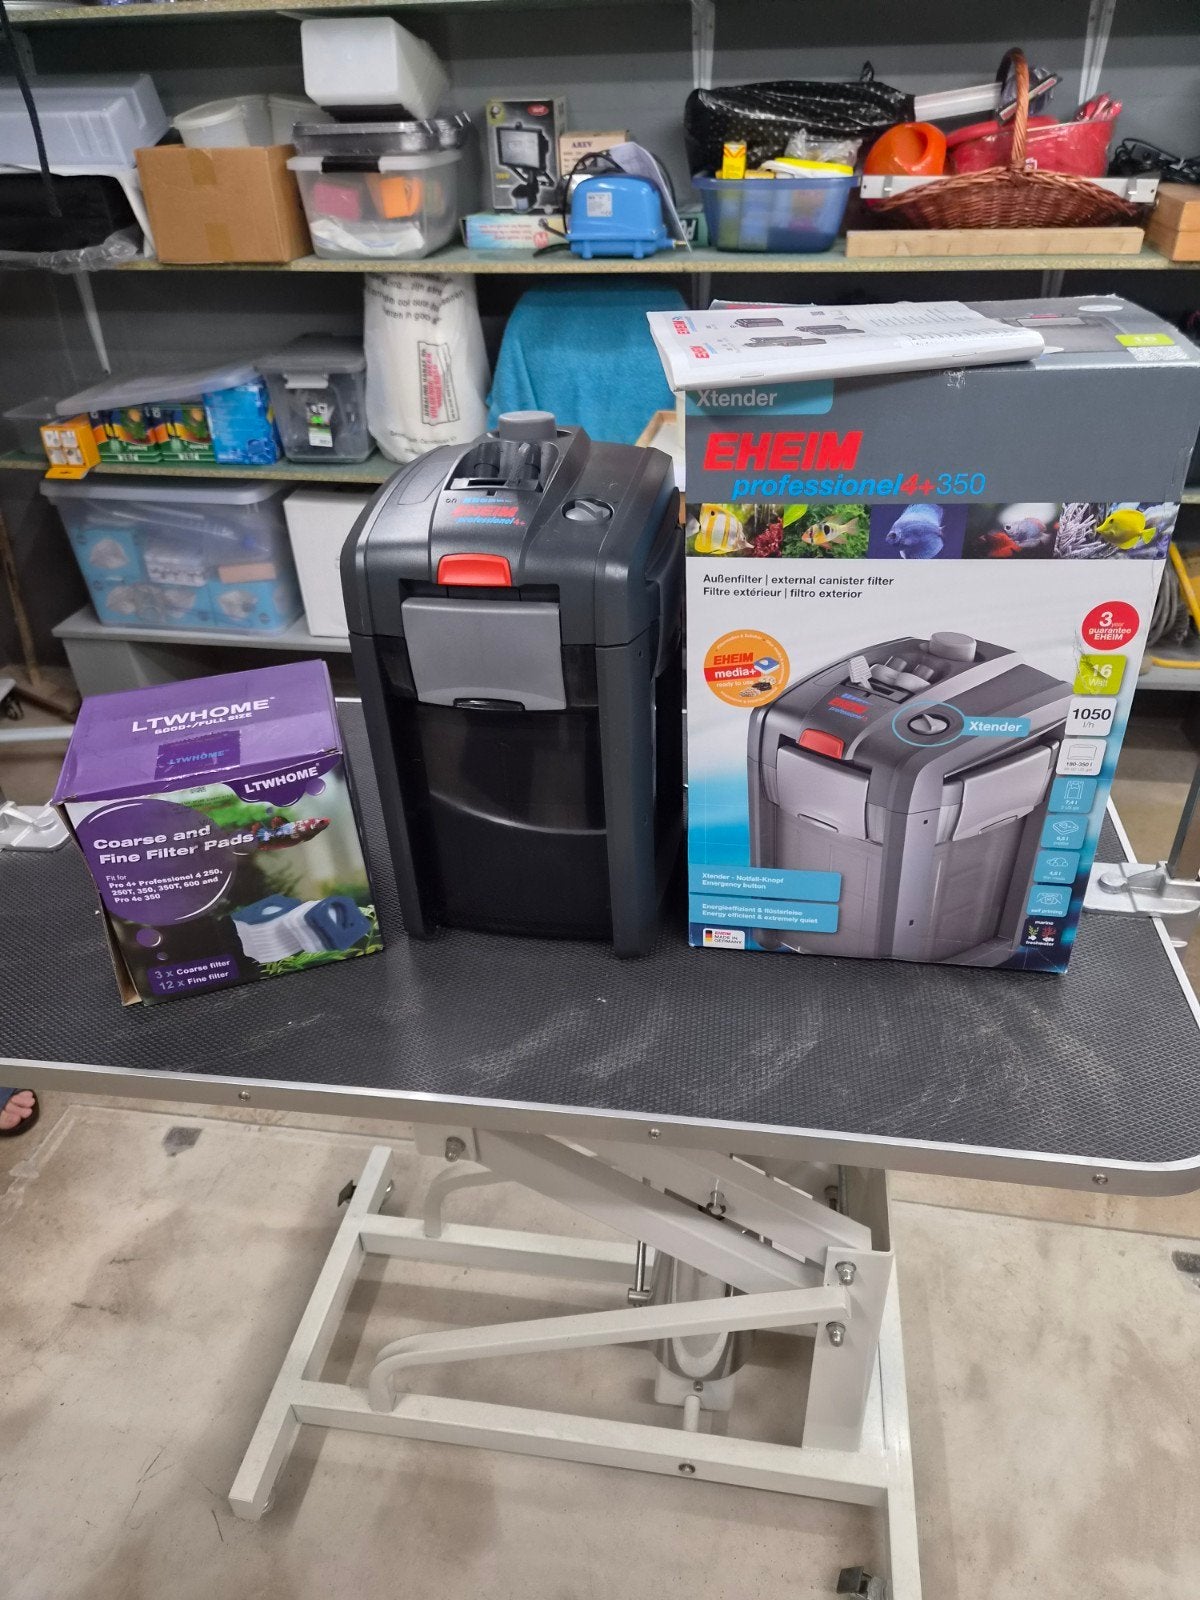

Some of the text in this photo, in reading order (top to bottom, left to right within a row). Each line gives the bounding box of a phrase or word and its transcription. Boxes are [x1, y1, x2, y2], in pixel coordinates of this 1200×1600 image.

[696, 389, 777, 407] Xtender
[703, 430, 864, 471] EHEIM
[703, 574, 763, 584] Außenfilter
[771, 576, 816, 585] external
[818, 576, 866, 586] canister
[867, 576, 895, 586] filter
[703, 587, 731, 597] Filtre
[733, 587, 782, 598] extérieur
[790, 588, 816, 598] filtro
[818, 590, 863, 599] exterior
[1099, 611, 1113, 627] 3
[1088, 627, 1132, 635] guarantee
[713, 653, 754, 665] EHEIM
[715, 668, 757, 679] media+
[1092, 664, 1113, 679] 16
[132, 699, 270, 733] LTWHOME
[228, 711, 253, 721] SIZE
[1073, 708, 1112, 720] 1050
[969, 722, 1022, 732] Xtender
[167, 750, 225, 766] LTWHOME
[244, 766, 319, 794] LTWHOME
[93, 825, 211, 850] Coarse and
[99, 833, 254, 865] Fine Filter Pads
[105, 874, 116, 882] Fit
[203, 868, 223, 877] 250,
[736, 874, 784, 884] Notfall-Knopf
[137, 887, 157, 895] 350,
[158, 883, 182, 892] 350T,
[183, 880, 200, 888] 600
[202, 876, 219, 885] and
[702, 880, 767, 890] Emergency button
[702, 903, 756, 913] Energieeffizient
[702, 910, 726, 918] Energy
[727, 912, 756, 920] efficient
[764, 915, 799, 923] extremely
[800, 917, 819, 925] quiet
[154, 960, 230, 979] 3 x Coarse filter
[159, 980, 175, 991] 12
[187, 976, 207, 985] Fine
[208, 971, 229, 980] filter
